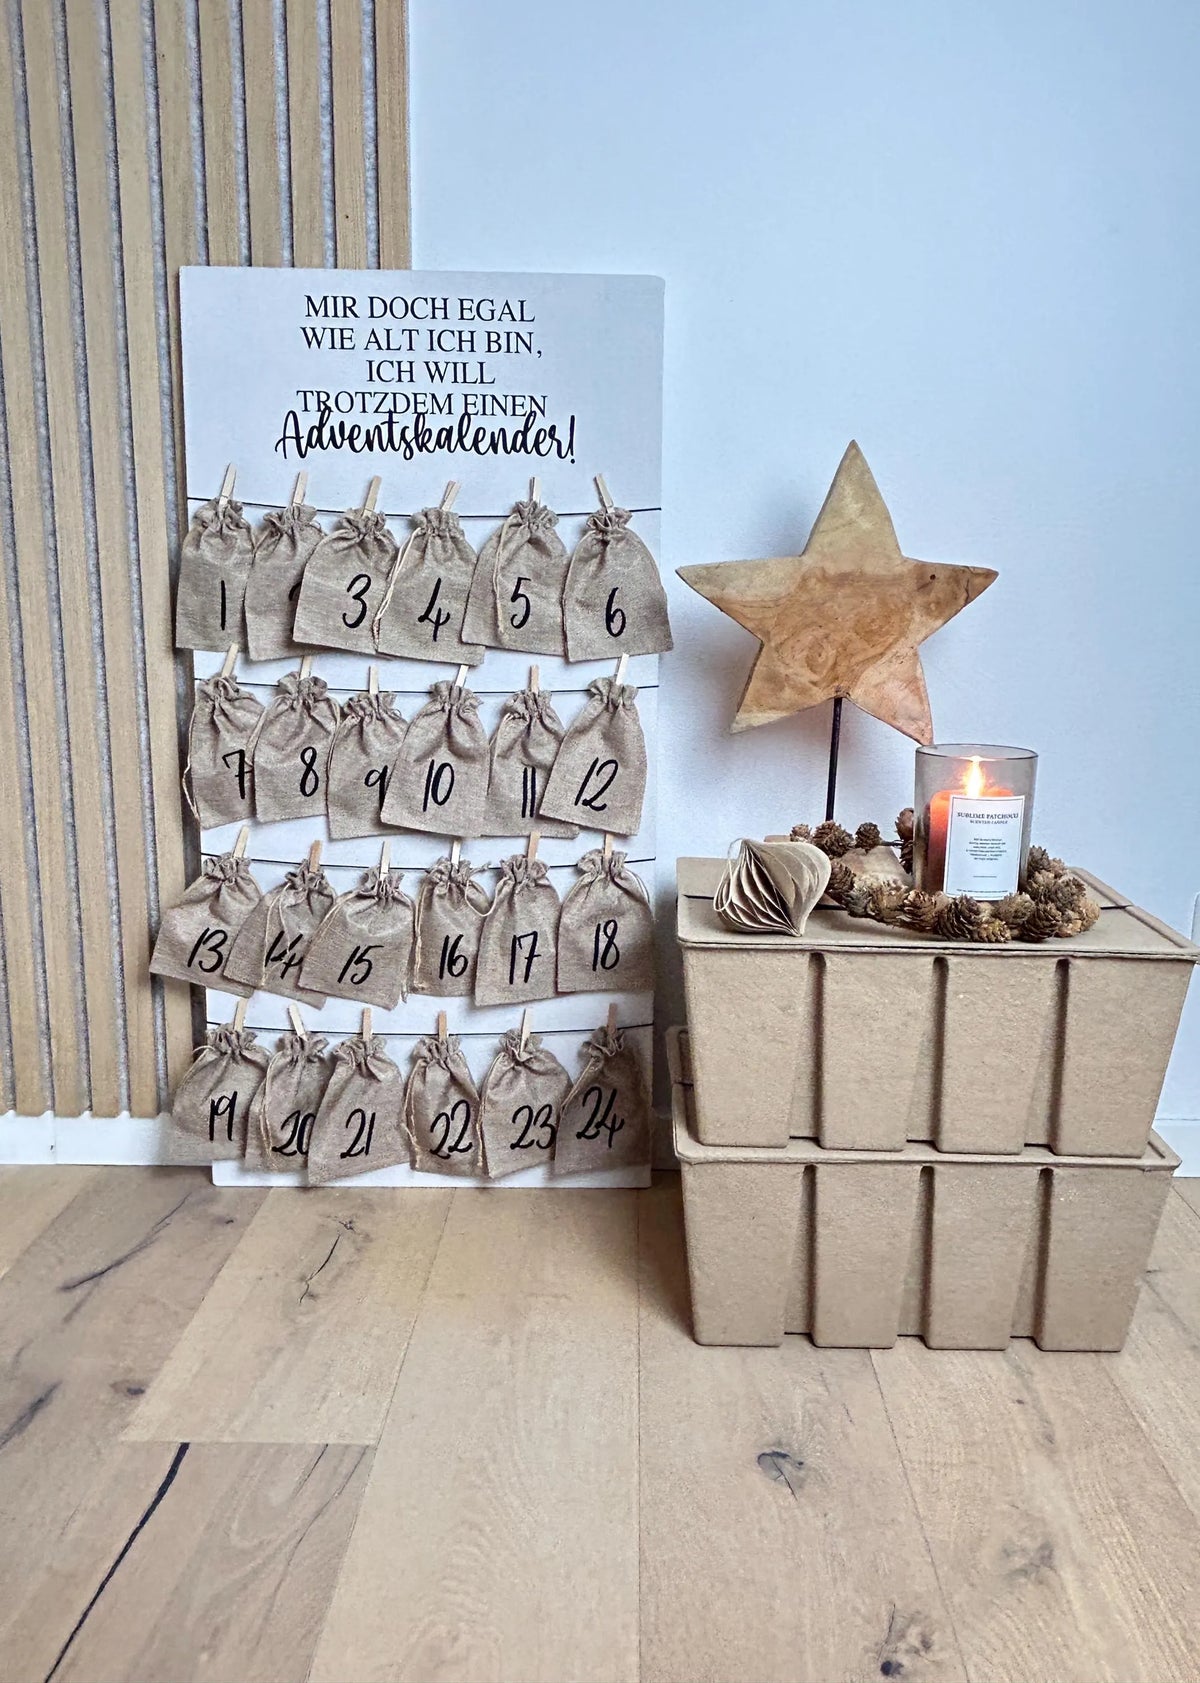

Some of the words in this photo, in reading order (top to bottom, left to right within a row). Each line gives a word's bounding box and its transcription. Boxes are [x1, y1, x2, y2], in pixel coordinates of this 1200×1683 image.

[304, 294, 360, 320] MIR
[368, 296, 448, 321] DOCH
[457, 298, 536, 322] EGAL
[300, 327, 355, 350] WIE
[364, 328, 420, 352] ALT
[428, 329, 477, 353] ICH
[485, 331, 543, 358] BIN,
[366, 360, 415, 383] ICH
[424, 361, 496, 384] WILL
[297, 390, 455, 416] TROTZDEM
[463, 393, 547, 417] EINEN
[275, 405, 577, 464] Adventskalender!
[220, 579, 227, 631] 1
[342, 573, 372, 629] 3
[417, 577, 451, 643] 4
[510, 576, 531, 630] 5
[605, 586, 627, 638] 6
[221, 748, 254, 800] 7
[299, 746, 320, 798] 8
[363, 764, 389, 812] 9
[422, 759, 455, 812] 10
[520, 765, 537, 819] 11
[574, 757, 619, 812] 12
[187, 927, 228, 973] 13
[264, 930, 305, 980] 14
[337, 944, 385, 986] 15
[438, 934, 469, 980] 16
[509, 930, 542, 985] 17
[591, 919, 621, 972] 18
[208, 1091, 238, 1142] 19
[339, 1108, 376, 1160] 21
[428, 1099, 473, 1160] 22
[509, 1103, 557, 1150] 23
[575, 1085, 626, 1149] 24
